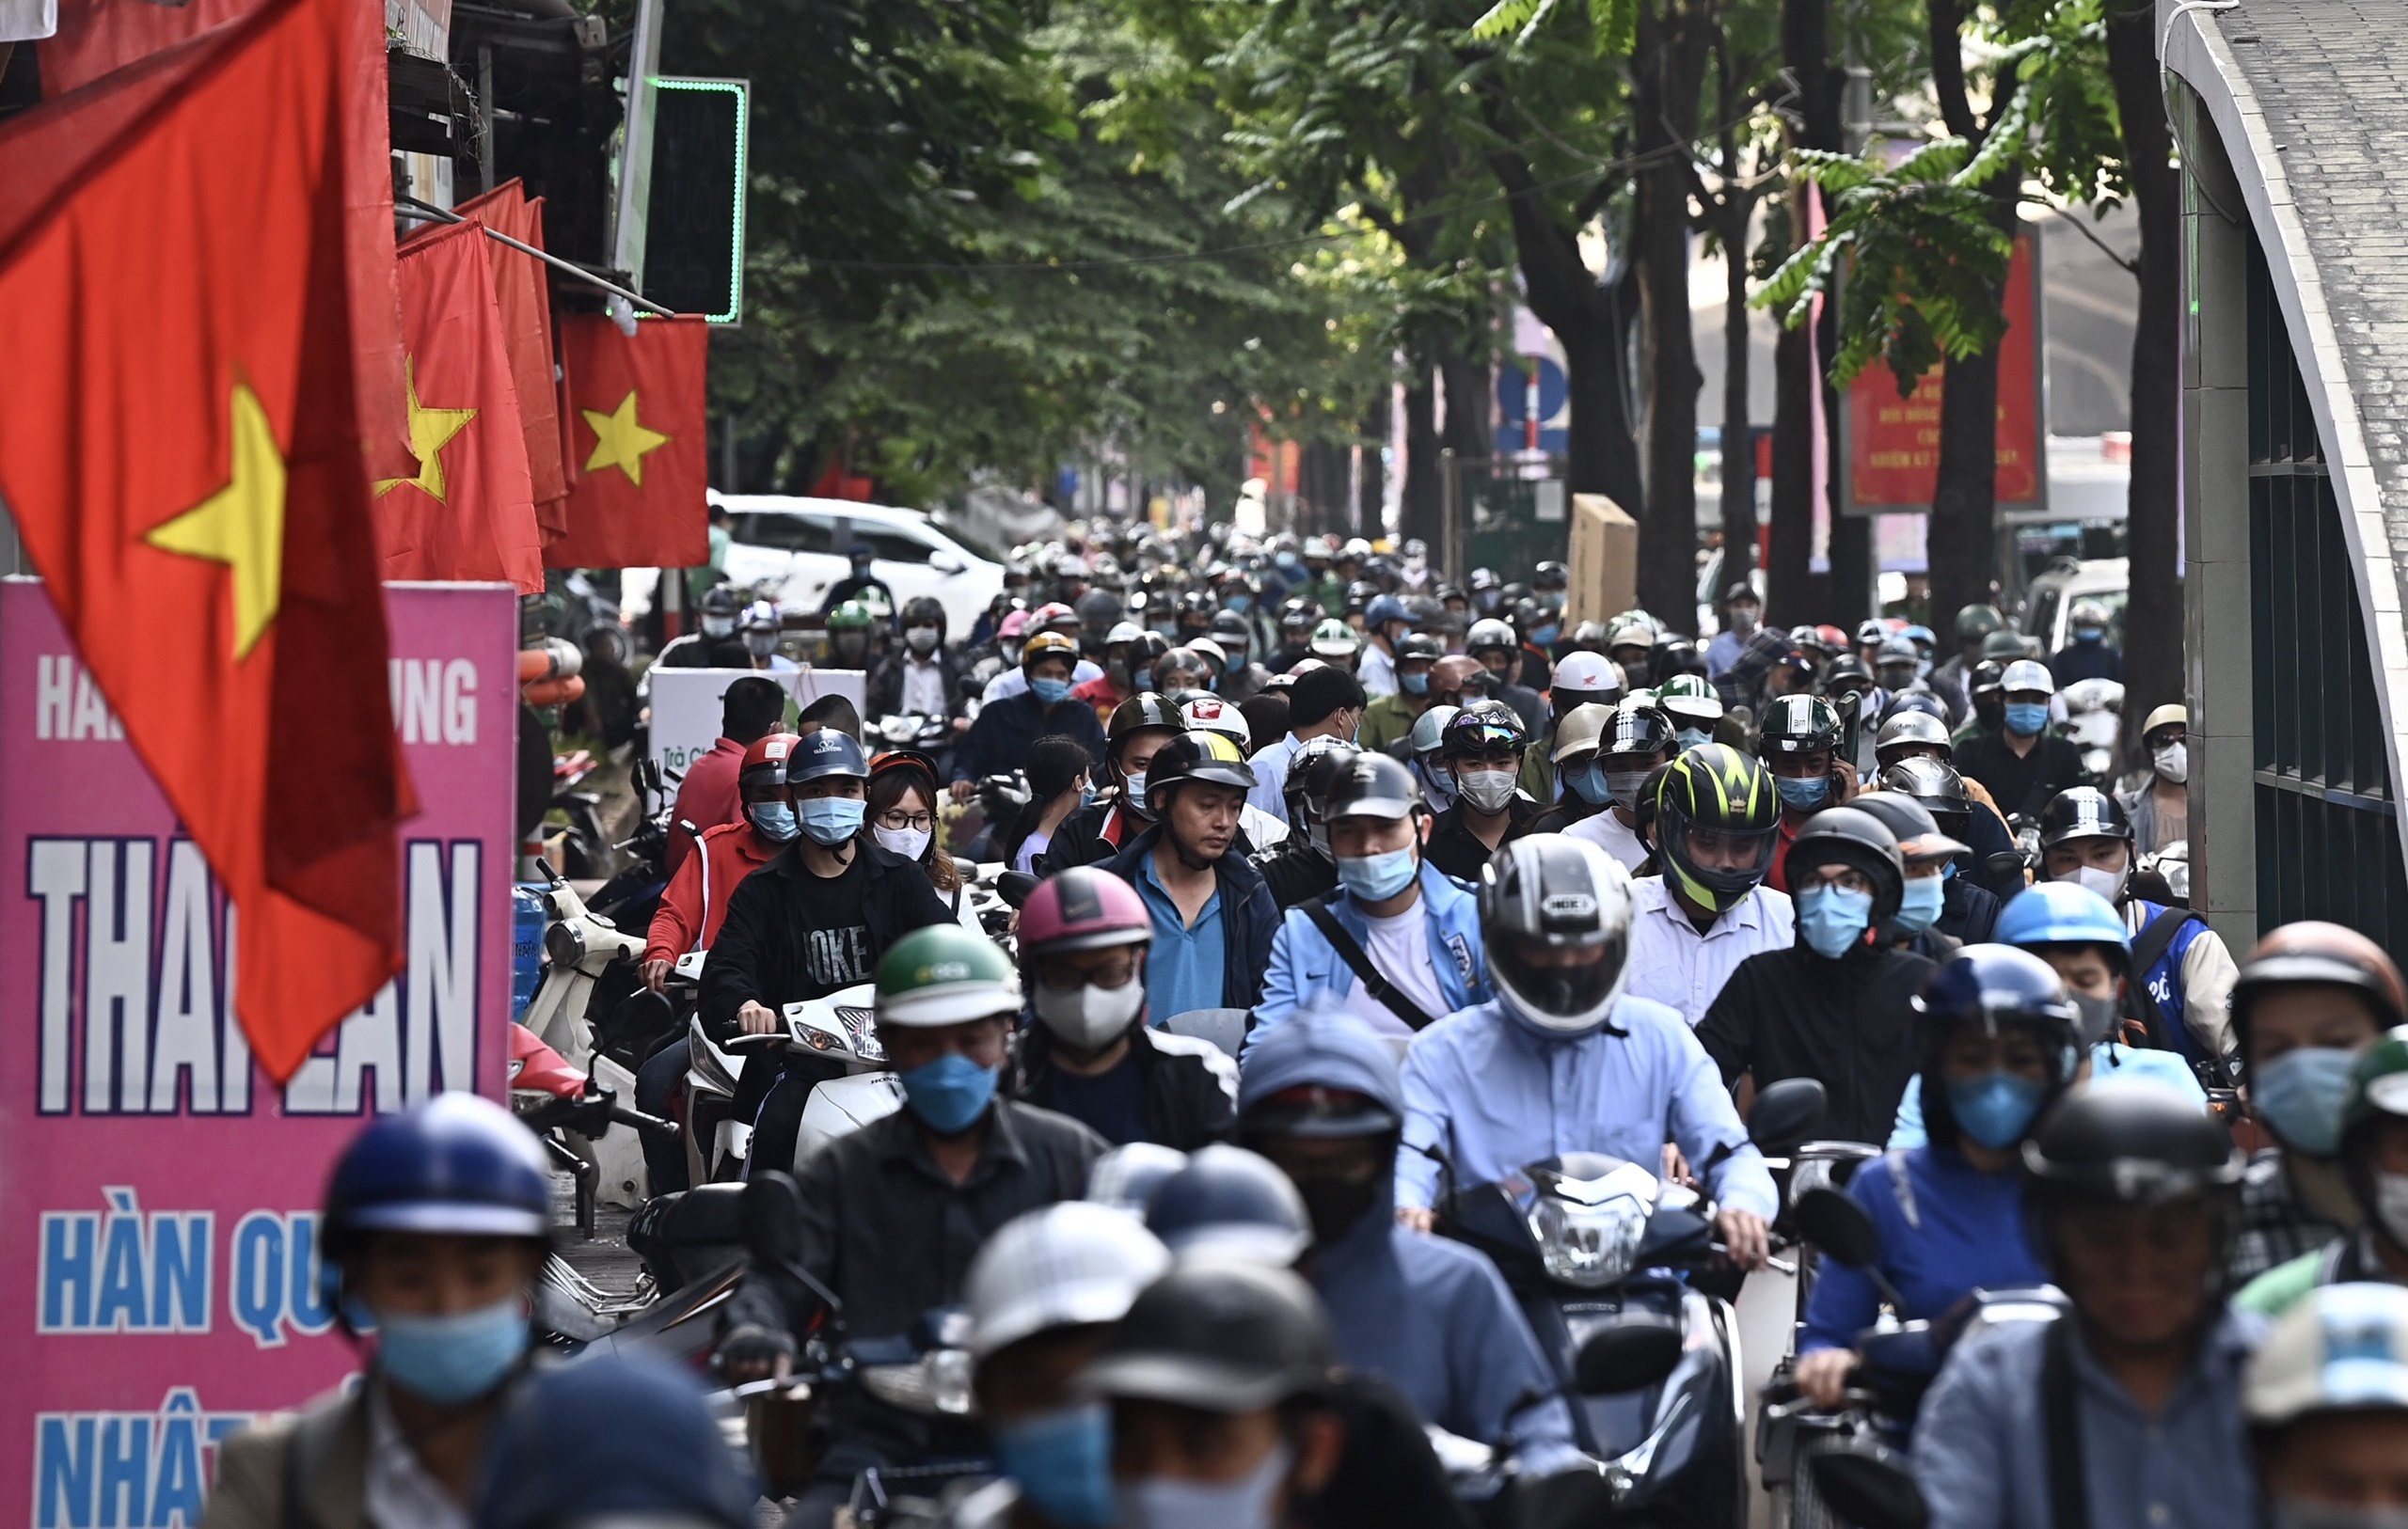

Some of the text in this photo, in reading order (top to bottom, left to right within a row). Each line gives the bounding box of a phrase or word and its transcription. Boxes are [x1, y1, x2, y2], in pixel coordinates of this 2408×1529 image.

[662, 745, 685, 768] Trà
[282, 837, 483, 1116] AN
[870, 1076, 901, 1084] HOND
[35, 1185, 380, 1350] HÀN QU
